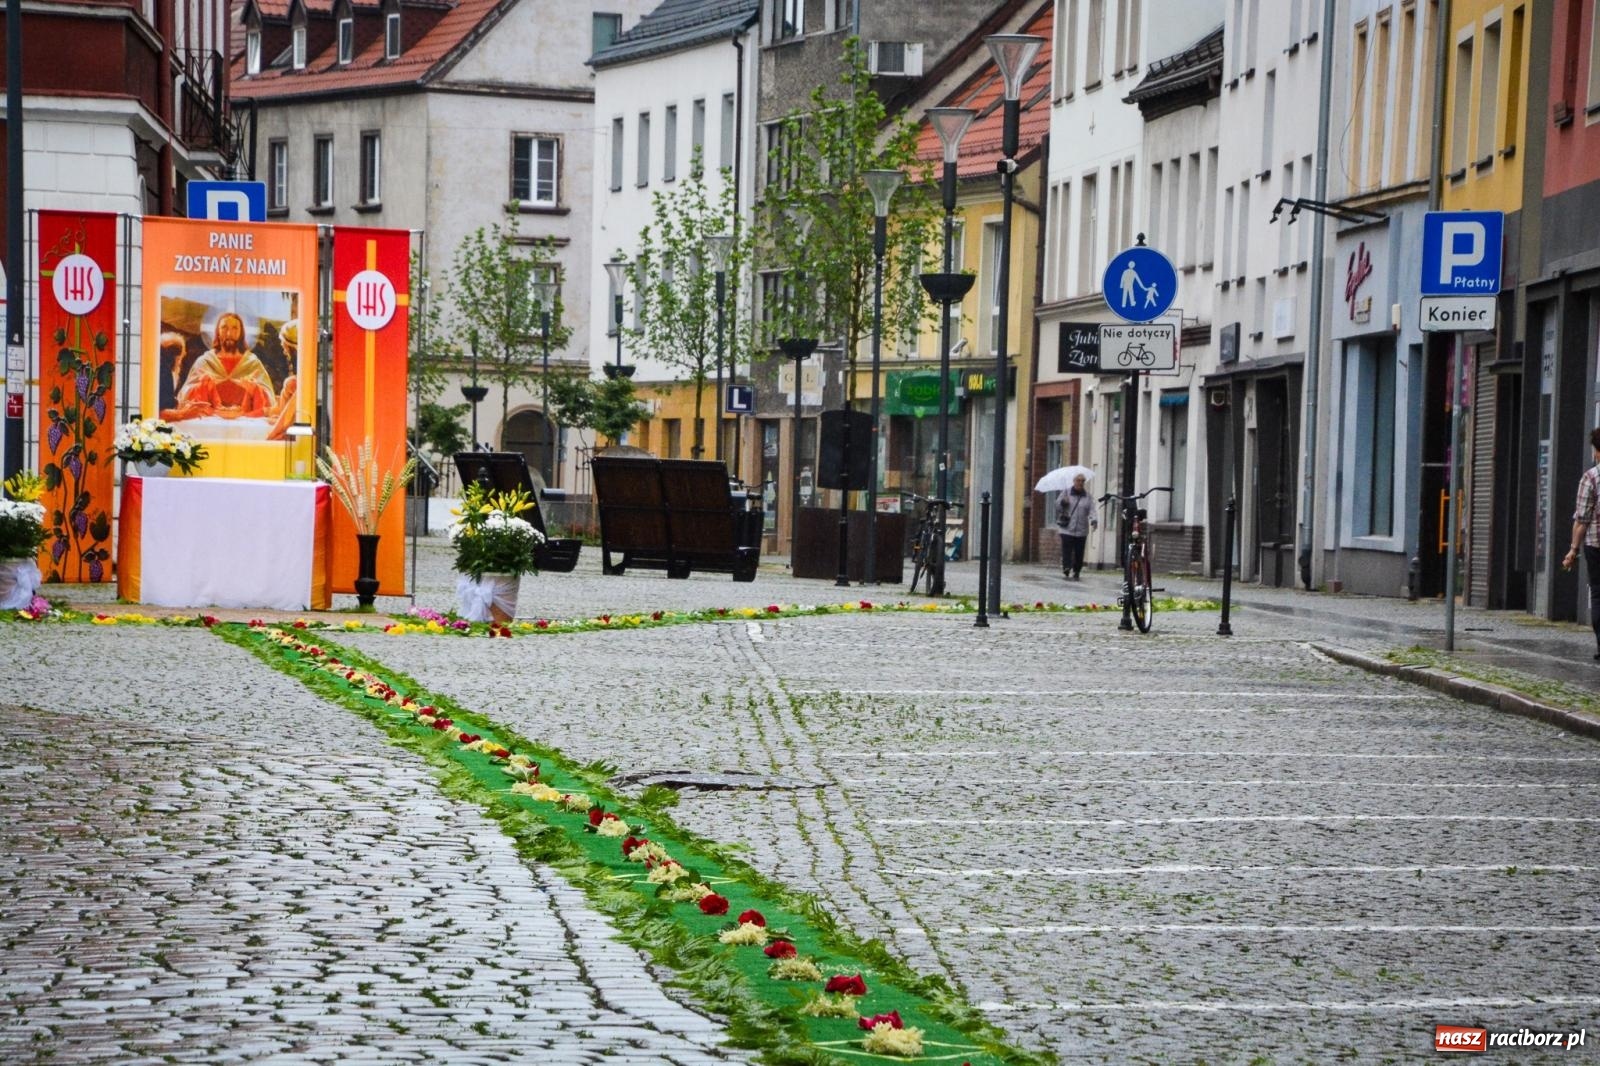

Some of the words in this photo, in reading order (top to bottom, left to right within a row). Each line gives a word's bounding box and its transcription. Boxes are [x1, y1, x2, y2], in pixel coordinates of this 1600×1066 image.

[209, 231, 253, 250] PANIE
[1440, 221, 1485, 284] P
[174, 254, 230, 273] ZOSTAŃ
[234, 258, 243, 274] Z
[246, 259, 286, 275] NAMI
[64, 266, 94, 301] IHS
[1454, 276, 1495, 290] Płatny
[357, 282, 386, 317] IHS
[1429, 306, 1487, 321] Koniec
[1103, 328, 1122, 338] Nie
[1128, 328, 1171, 340] dotyczy
[733, 388, 747, 409] L
